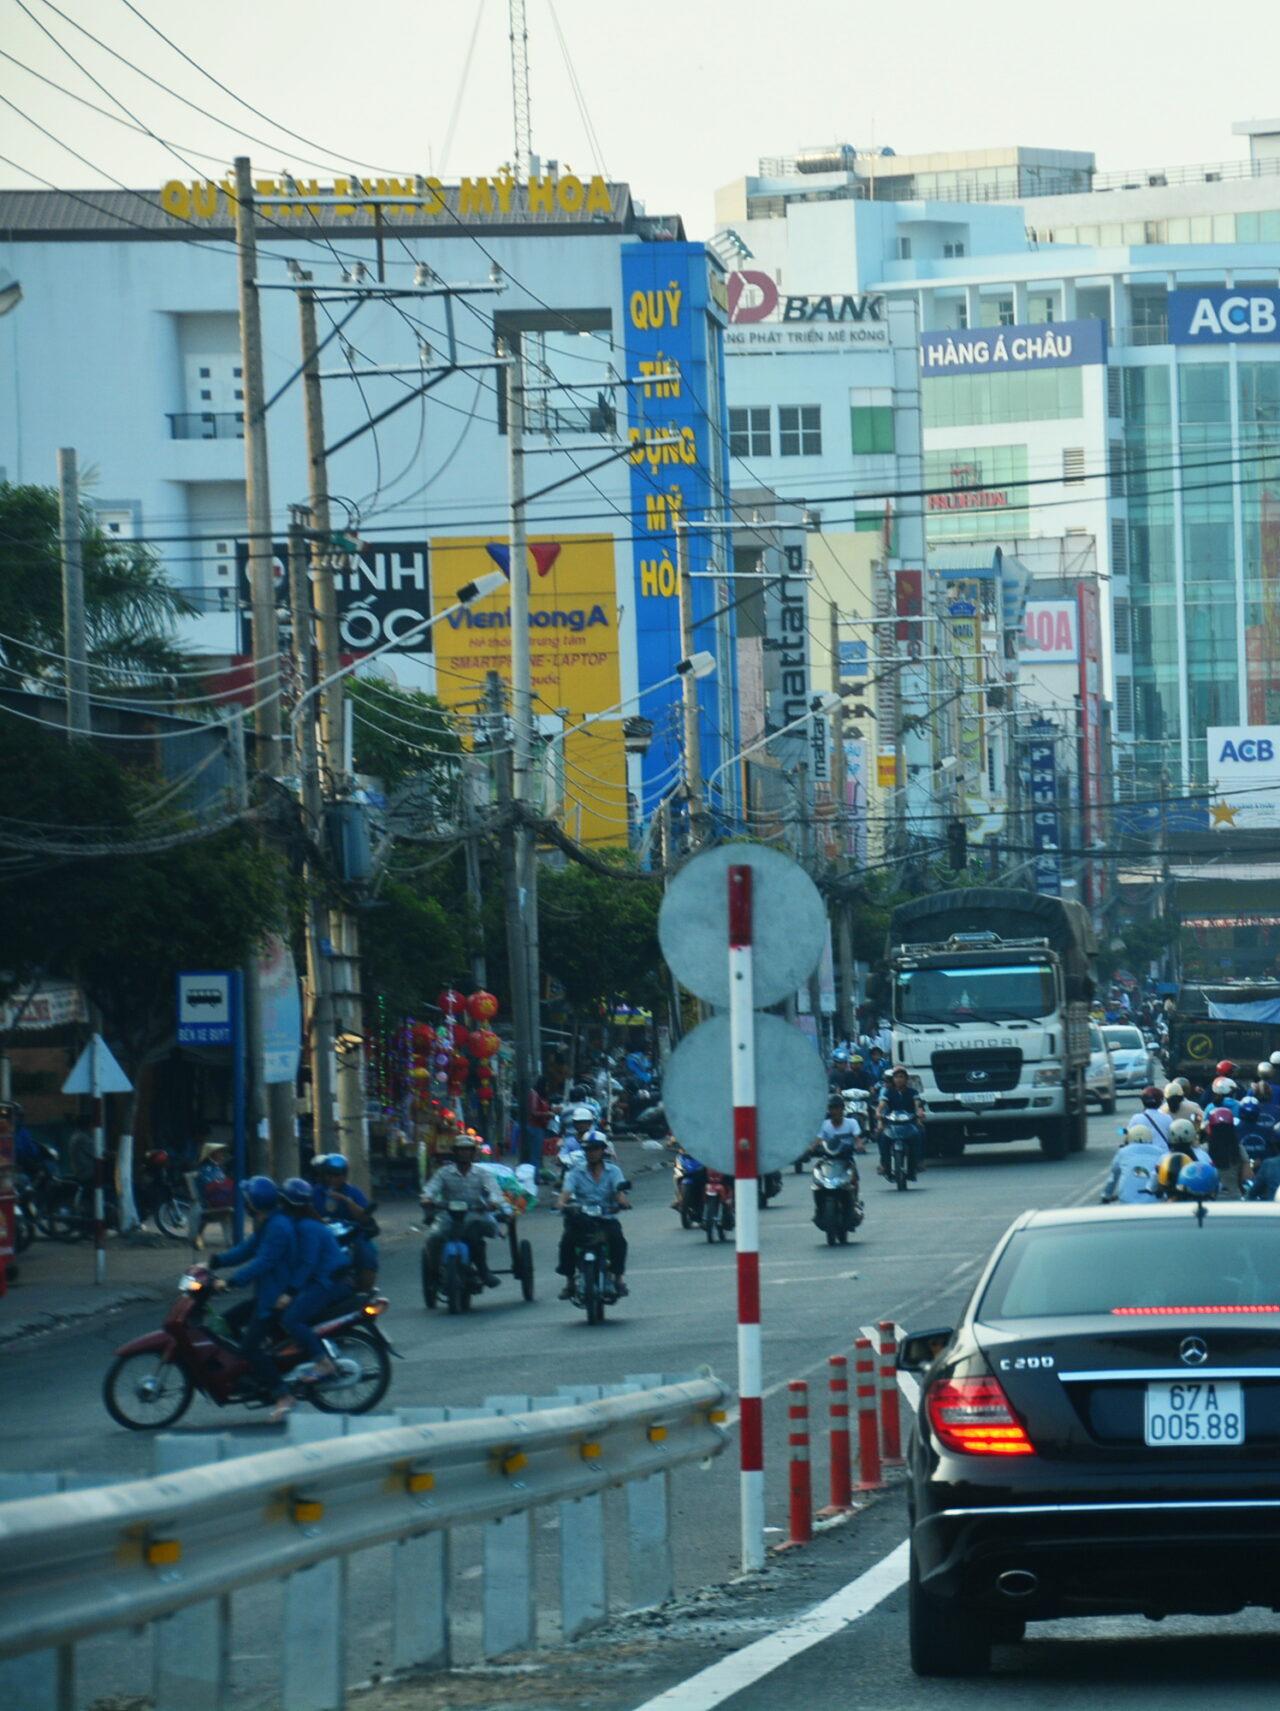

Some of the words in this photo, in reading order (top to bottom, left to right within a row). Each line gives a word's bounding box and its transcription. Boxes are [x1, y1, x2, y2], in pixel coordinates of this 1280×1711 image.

[528, 163, 613, 213] HÒA
[629, 280, 683, 330] QUỸ
[782, 295, 885, 323] BANK
[1188, 297, 1277, 336] ACB
[749, 330, 782, 344] PHÁT
[928, 337, 989, 368] HÀNG
[993, 333, 1009, 363] Á
[1012, 330, 1072, 360] CHÂU
[638, 351, 682, 399] TÍN
[627, 426, 697, 475] DỤNG
[640, 549, 681, 597] HÒ
[552, 652, 609, 670] LAPTOP
[1219, 738, 1275, 763] ACB
[934, 1037, 1020, 1051] HYUNDAI
[1000, 1358, 1011, 1371] C
[1014, 1356, 1055, 1369] 200
[1169, 1383, 1219, 1412] 67A
[1150, 1412, 1240, 1441] 005.88
